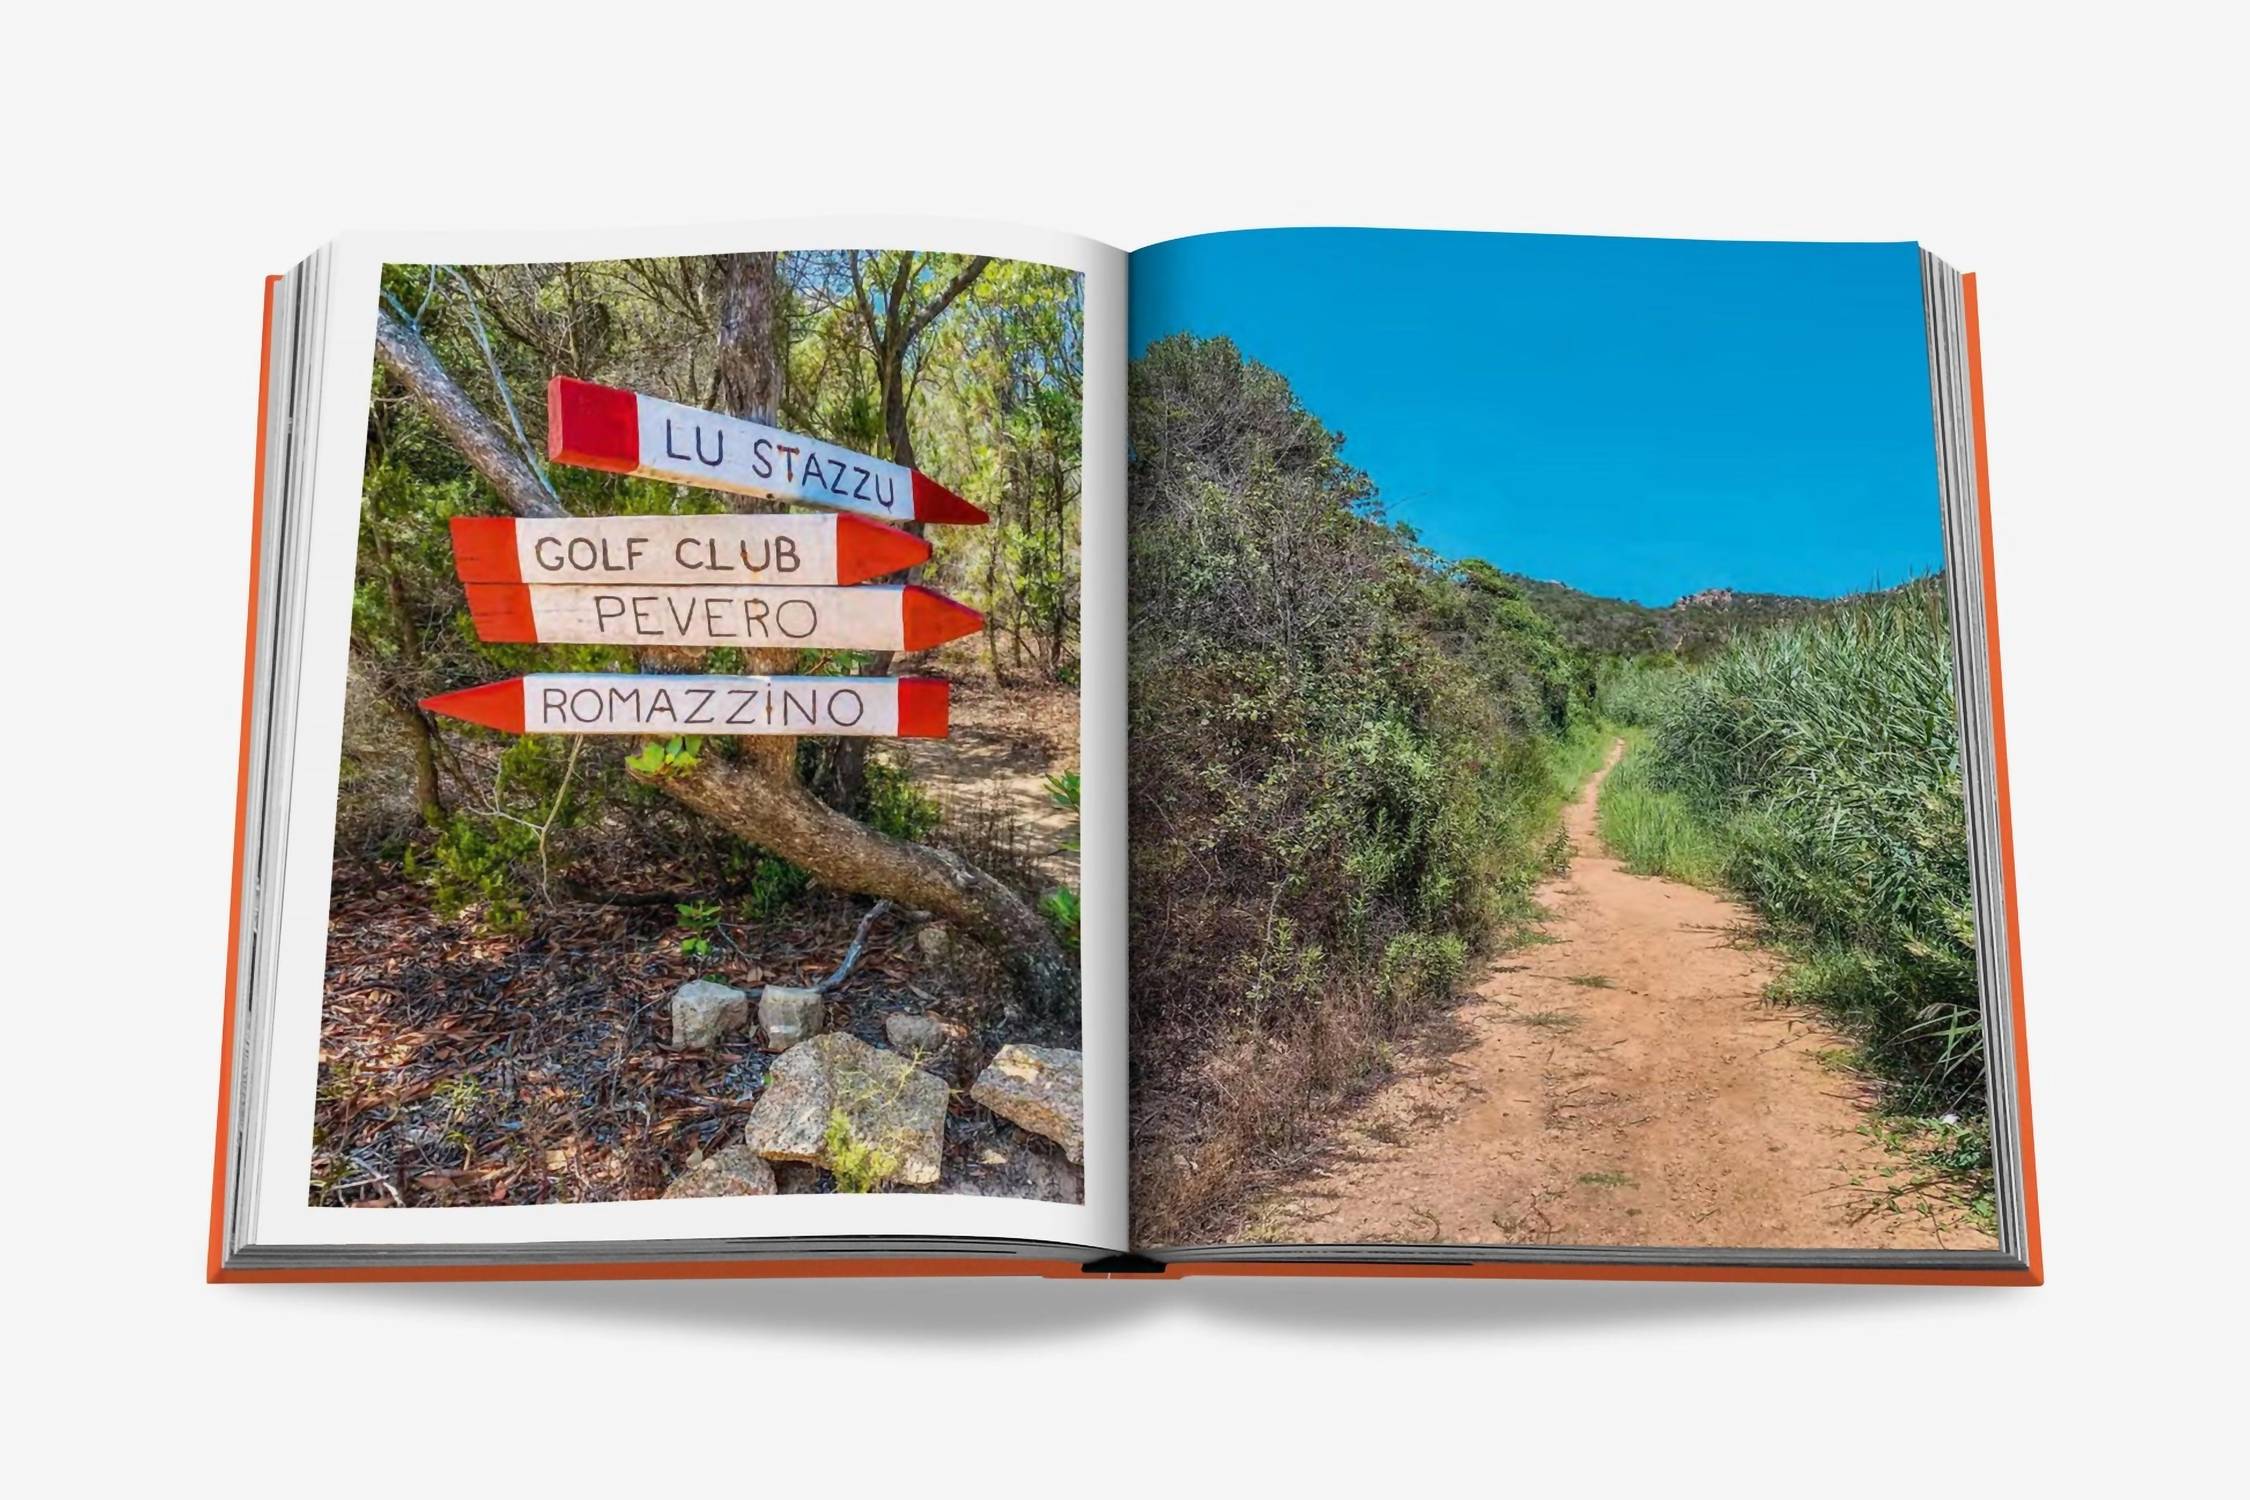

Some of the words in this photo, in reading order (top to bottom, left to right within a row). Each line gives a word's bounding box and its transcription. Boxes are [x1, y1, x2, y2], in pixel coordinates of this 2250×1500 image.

[665, 418, 724, 467] LU
[752, 439, 895, 510] STAZZU
[535, 537, 650, 572] GOLF
[675, 536, 801, 573] CLUB
[594, 595, 818, 638] PEVERO
